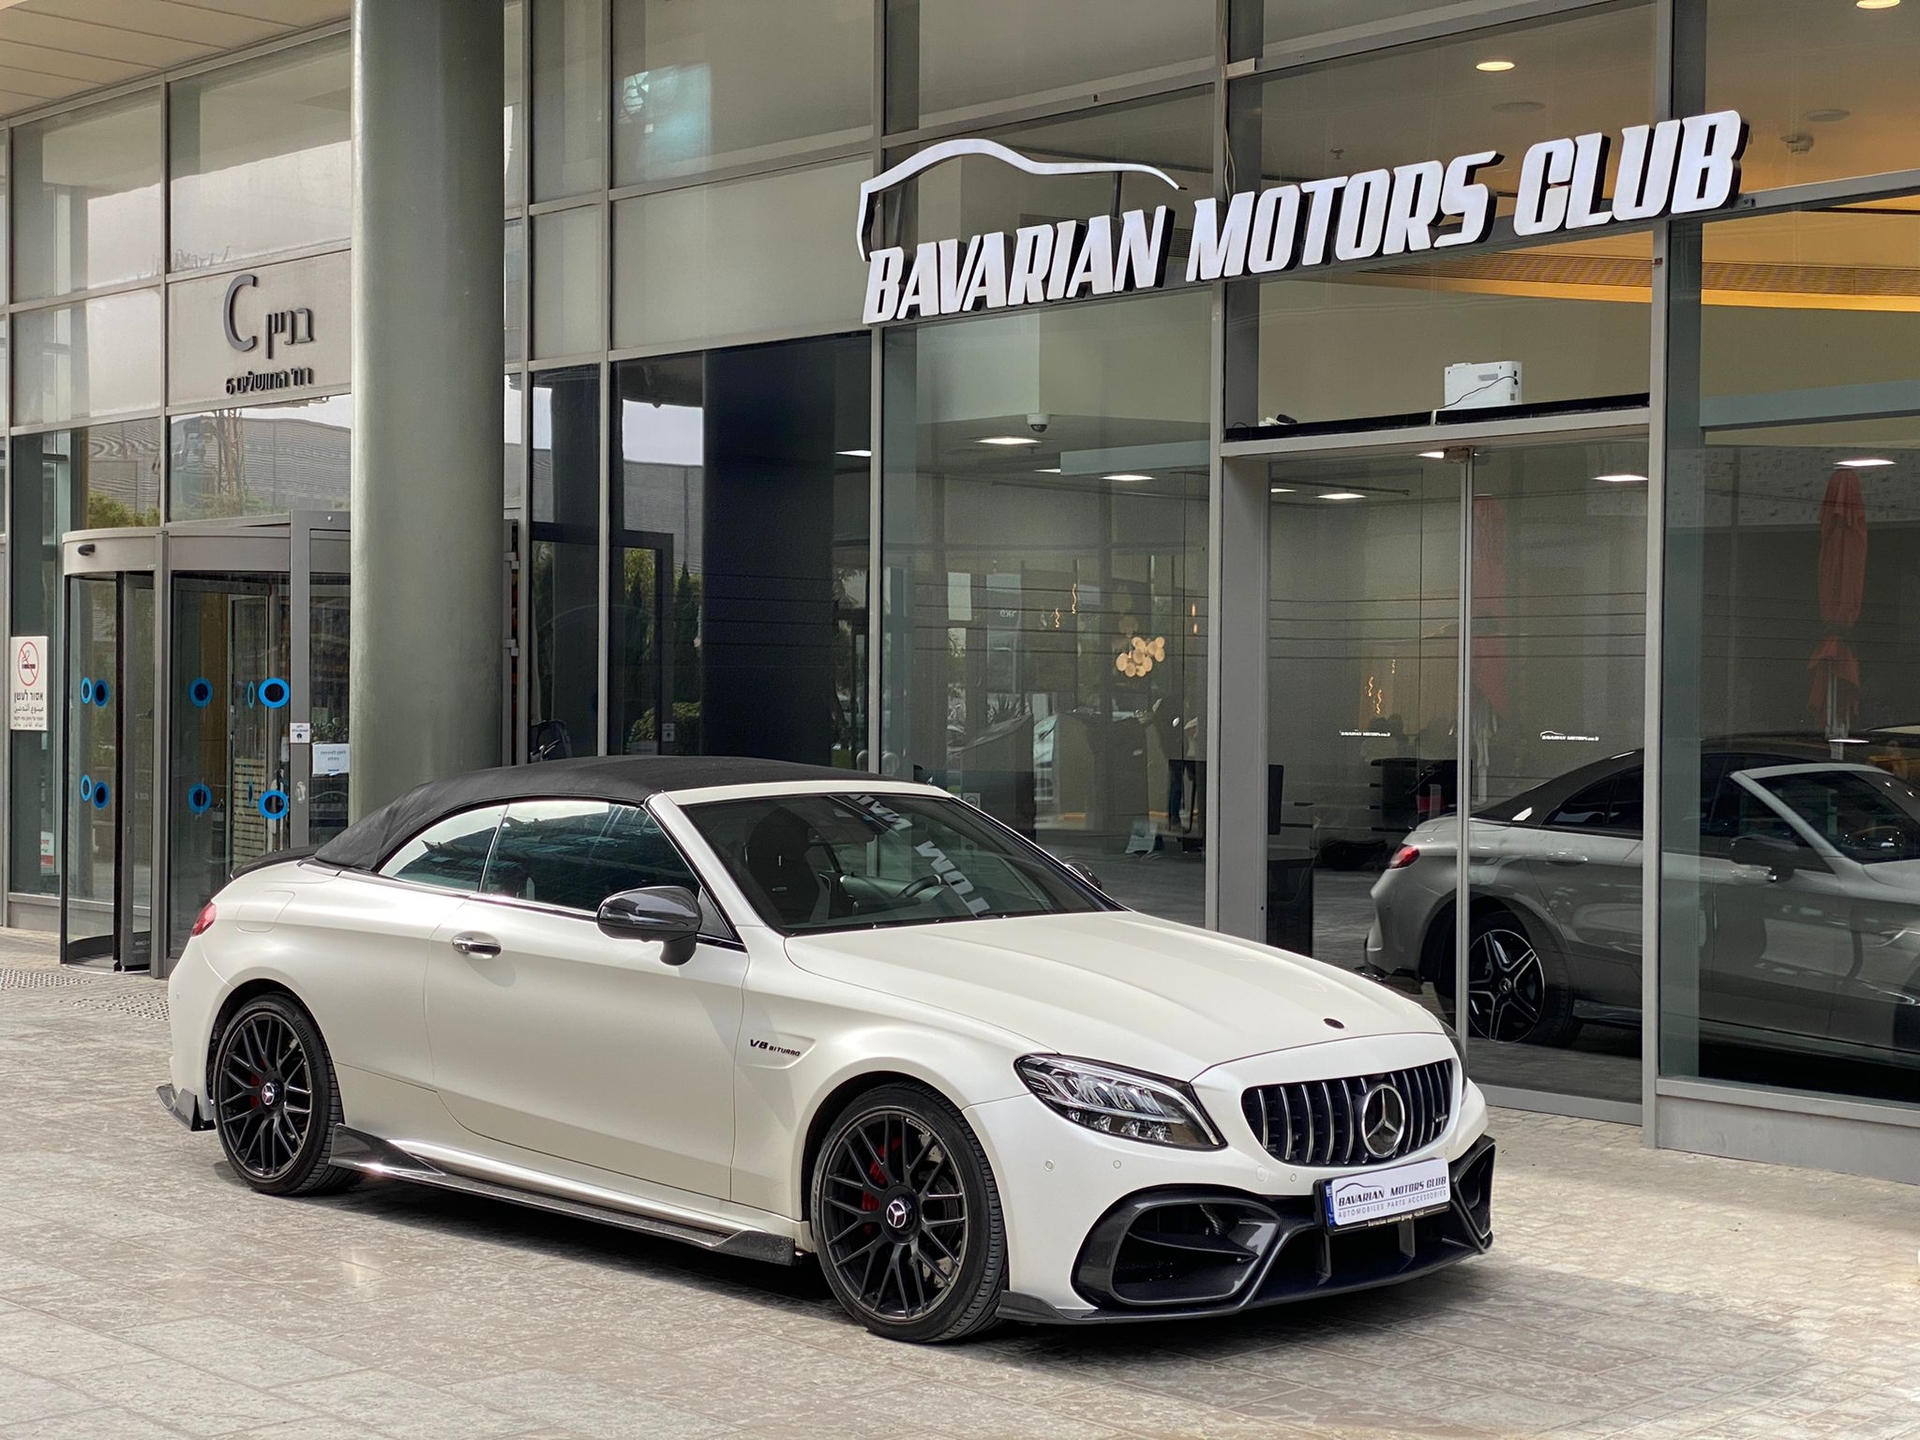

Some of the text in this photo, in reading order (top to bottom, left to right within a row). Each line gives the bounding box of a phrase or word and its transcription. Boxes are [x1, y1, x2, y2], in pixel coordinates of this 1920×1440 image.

[862, 110, 1746, 325] BAVARIAN MOTORS CLUB
[223, 274, 314, 360] בניין C
[225, 377, 236, 395] 6
[14, 689, 28, 703] לעשן
[750, 1039, 801, 1057] V8 BITURBO
[1338, 1176, 1447, 1206] BAVARIAN MOTORS CLUB
[1338, 1189, 1447, 1218] AUTOMOBILES PARTS ACCESSORIES
